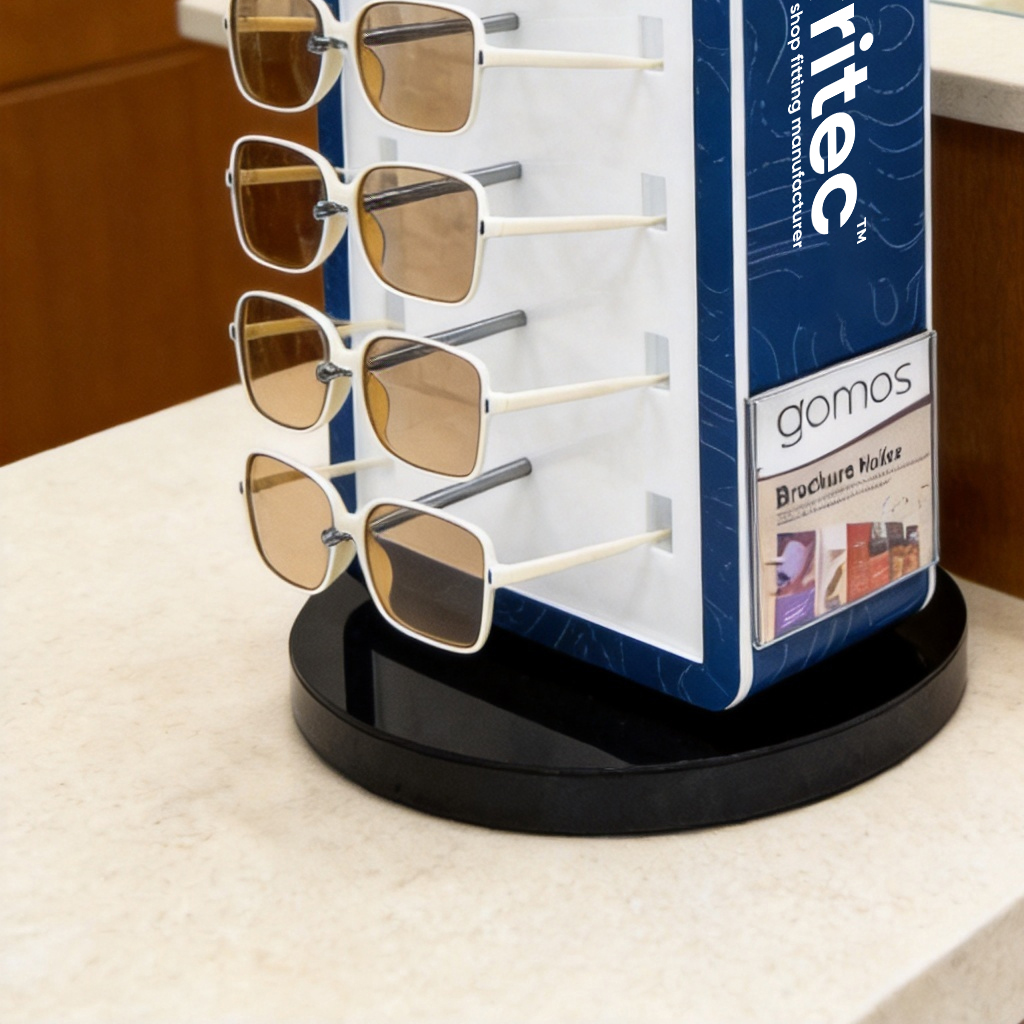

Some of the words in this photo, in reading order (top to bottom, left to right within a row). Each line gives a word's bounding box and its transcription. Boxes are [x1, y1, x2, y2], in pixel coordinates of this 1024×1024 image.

[787, 2, 804, 51] shop
[787, 53, 805, 115] fitting
[791, 116, 805, 249] manufacturer
[777, 362, 912, 449] gomos
